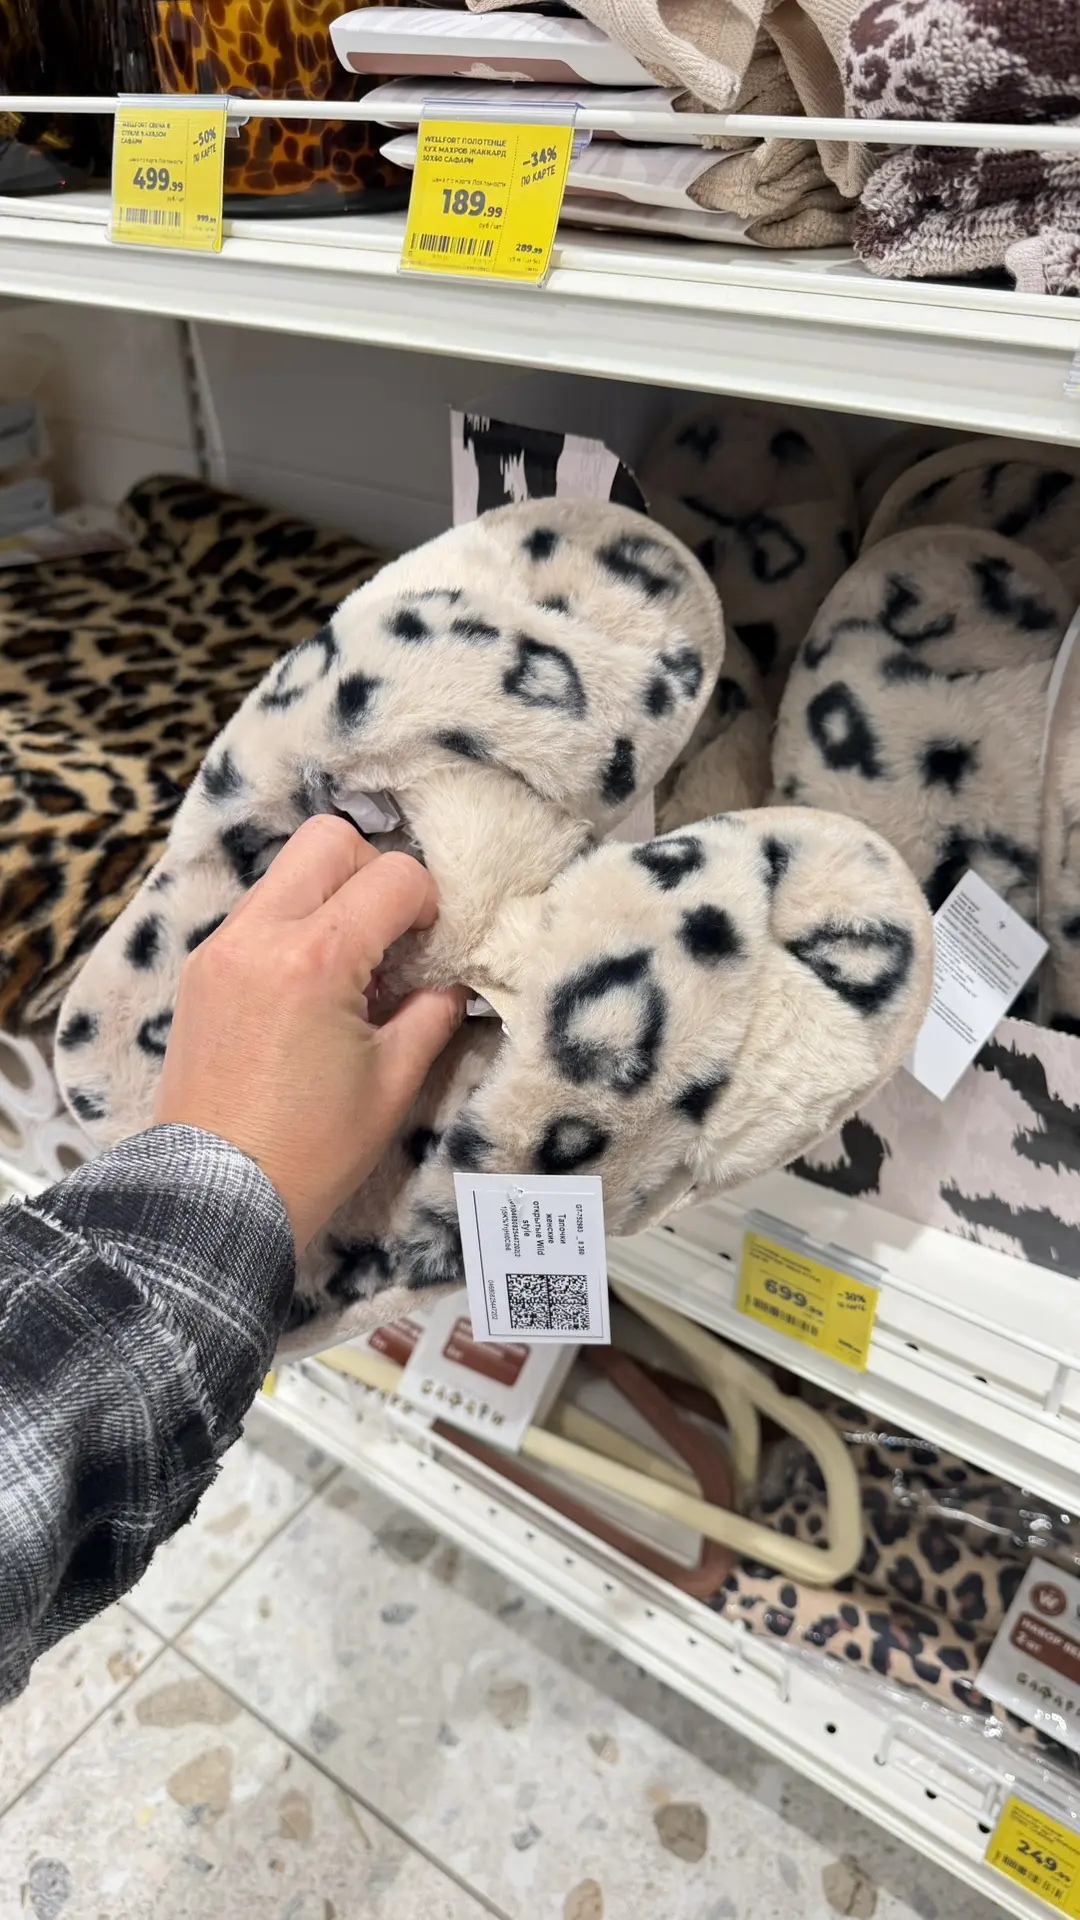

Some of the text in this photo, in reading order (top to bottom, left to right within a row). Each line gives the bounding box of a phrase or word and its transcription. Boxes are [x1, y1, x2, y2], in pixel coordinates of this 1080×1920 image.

[193, 127, 216, 146] -50%
[425, 136, 507, 147] WELLFORT ПОЛОТЕНЦЕ
[200, 144, 216, 159] КАРТЕ
[438, 147, 467, 155] МАХРОВ
[469, 148, 507, 158] ЖАККАРД
[444, 156, 474, 164] САФАРИ
[523, 146, 557, 168] -34%
[133, 167, 183, 192] 499.99
[521, 165, 556, 187] ПО КАРТЕ
[442, 188, 503, 218] 189.99
[515, 243, 543, 254] 289.99
[521, 1219, 531, 1237] style
[532, 1200, 545, 1255] открытые Wild
[546, 1213, 554, 1244] женские
[558, 1213, 566, 1244] Тапочки
